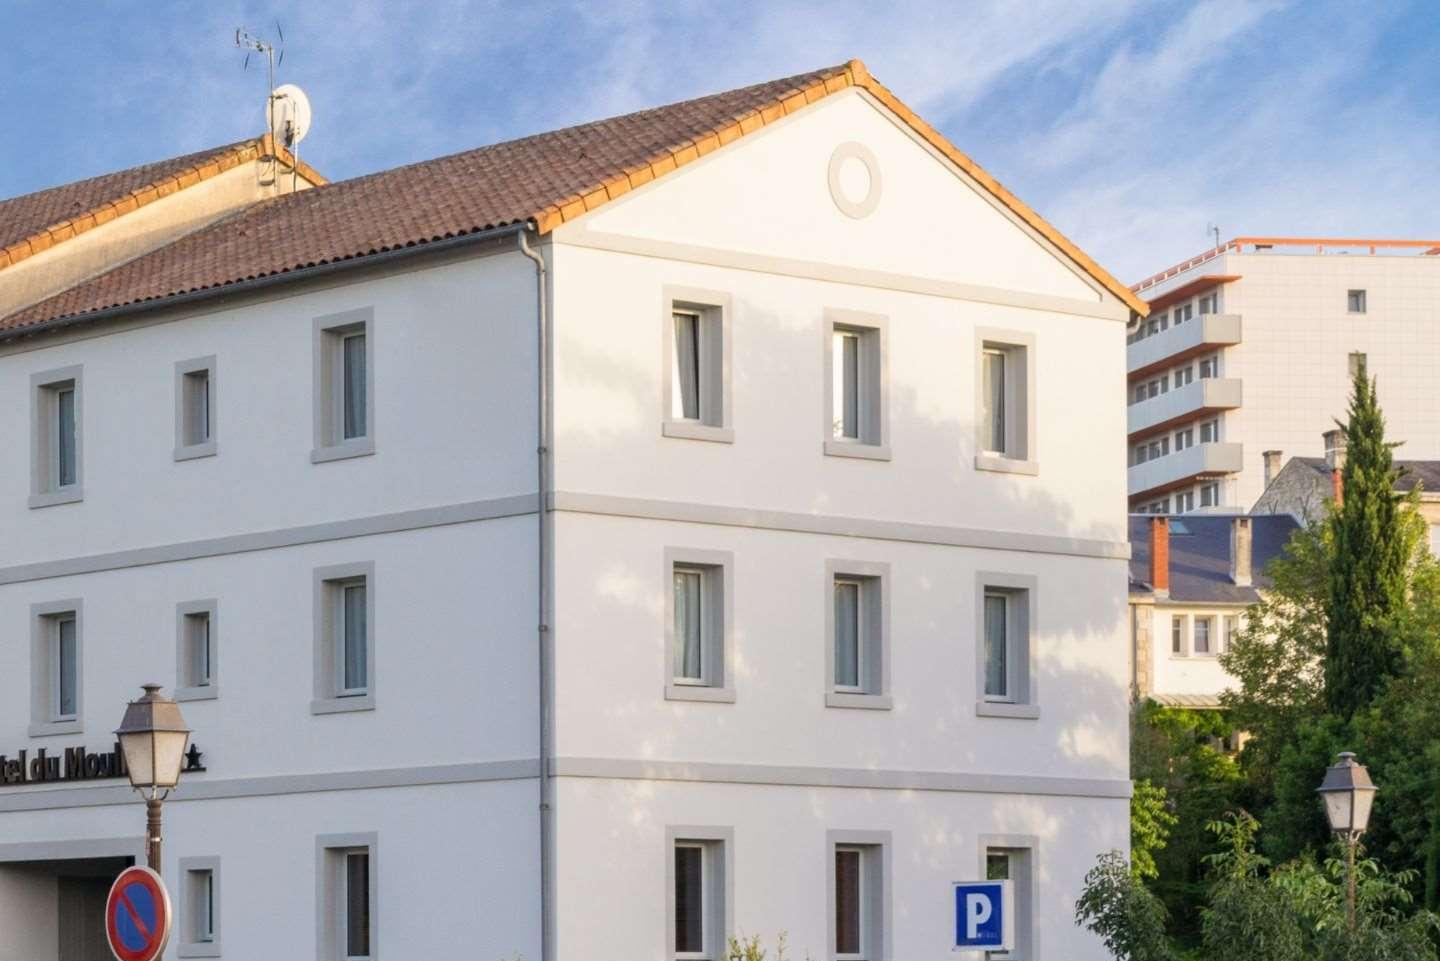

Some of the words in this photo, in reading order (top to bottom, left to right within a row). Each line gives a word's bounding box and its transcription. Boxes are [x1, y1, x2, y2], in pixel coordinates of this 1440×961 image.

[30, 748, 61, 782] du
[64, 743, 129, 780] Moul
[967, 893, 992, 939] P
